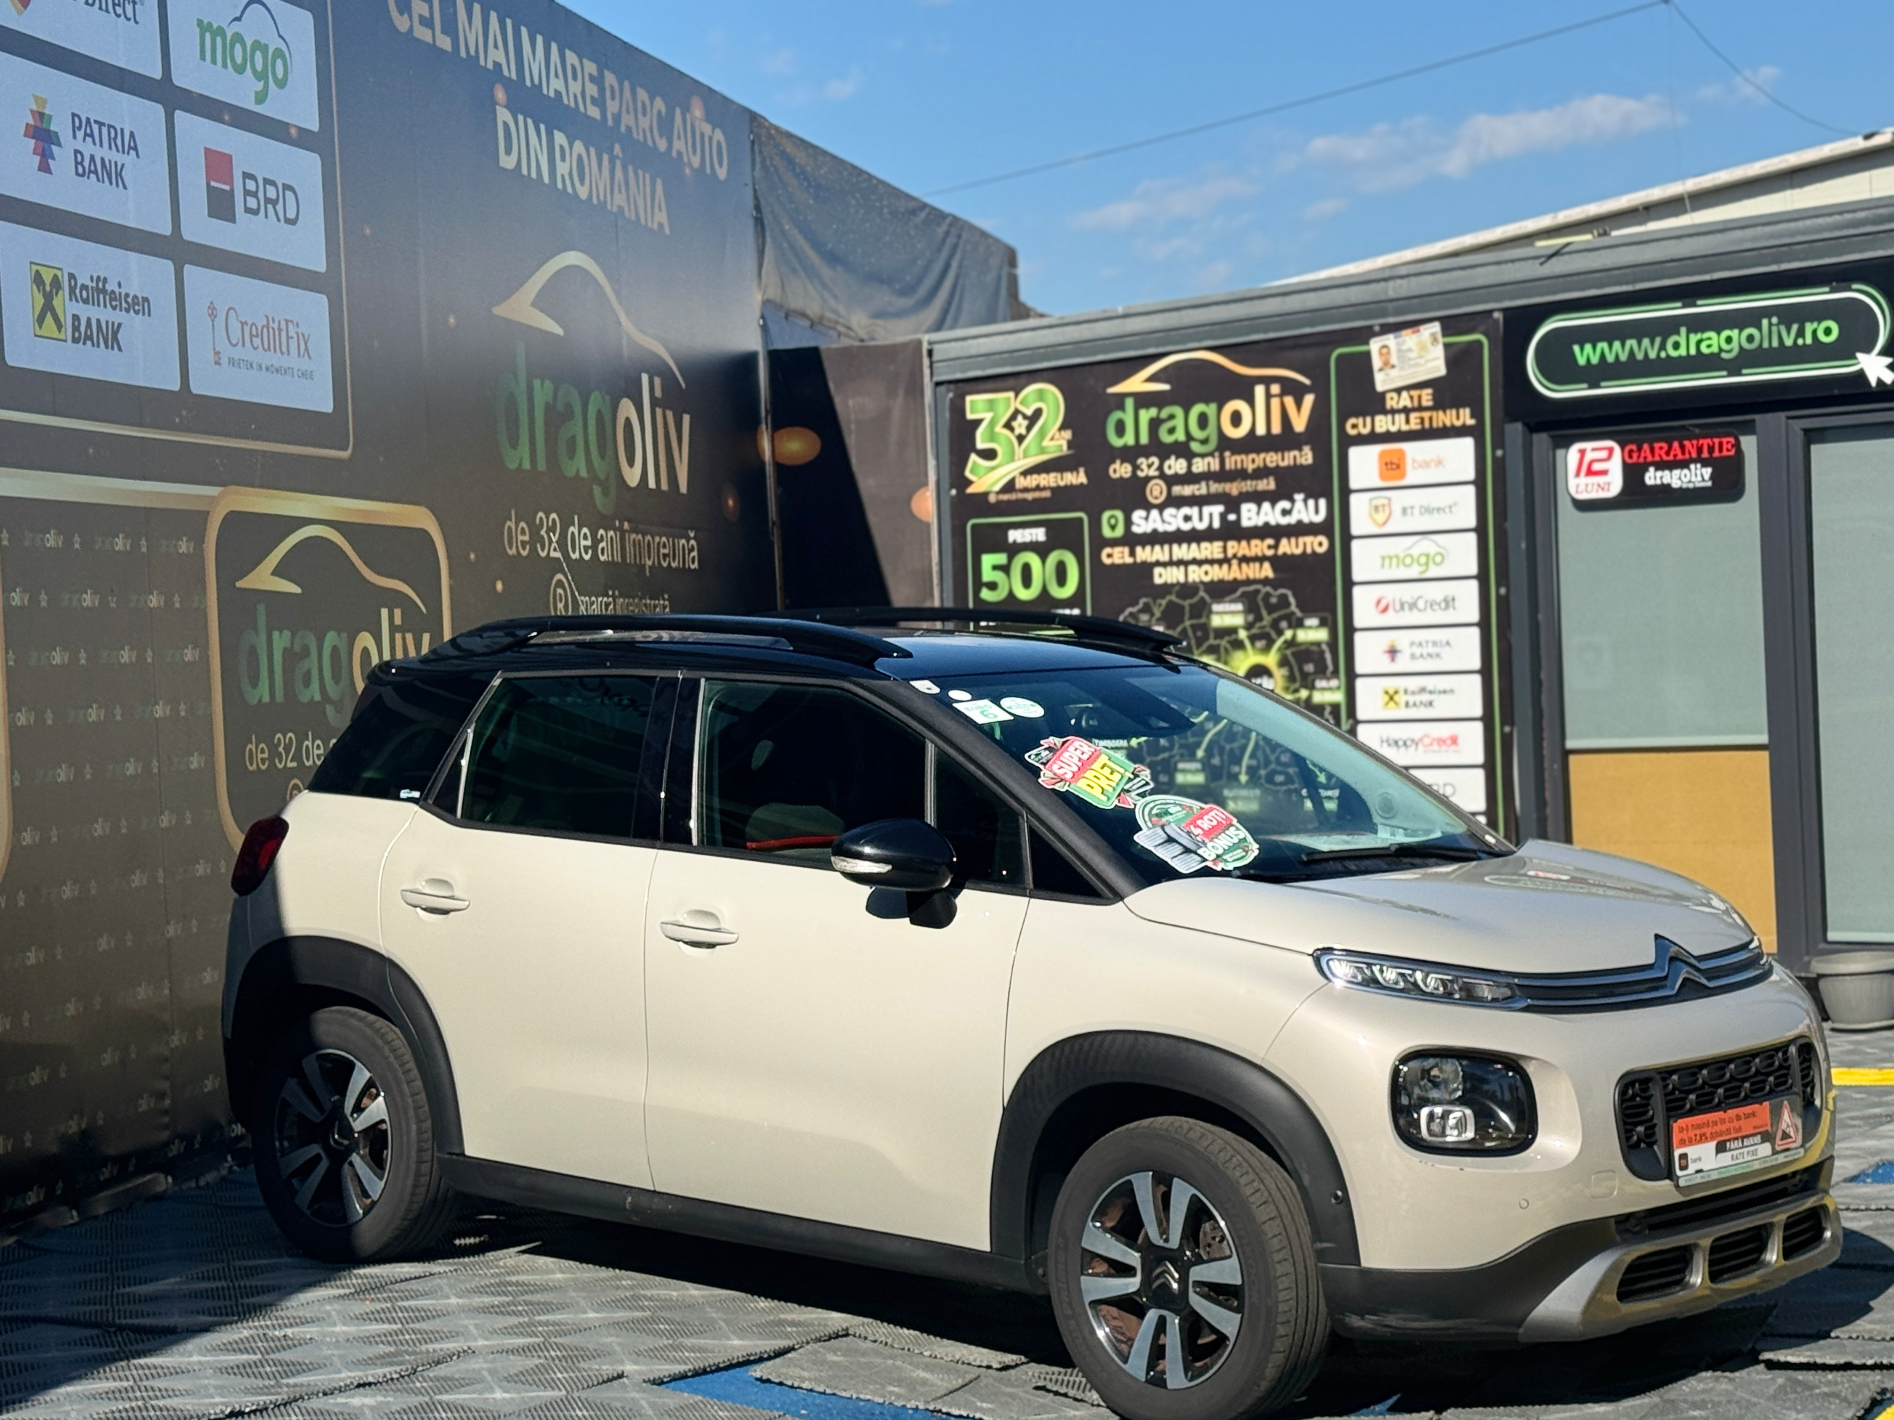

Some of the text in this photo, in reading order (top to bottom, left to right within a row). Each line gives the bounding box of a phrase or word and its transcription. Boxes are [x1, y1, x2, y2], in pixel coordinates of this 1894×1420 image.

[196, 17, 290, 105] mogo
[456, 0, 517, 81] MAI
[520, 25, 601, 122] MARE
[603, 68, 668, 152] PARC
[671, 105, 728, 182] AUTO
[70, 110, 141, 160] PATRIA
[72, 148, 129, 191] BANK
[495, 104, 671, 236] DIN ROMÂNIA
[241, 169, 301, 227] BRD
[66, 271, 152, 318] Raiffeisen
[70, 313, 124, 353] BANK
[223, 305, 313, 361] CreditFix
[1572, 315, 1841, 367] www.dragoliv.ro
[1104, 382, 1316, 455] dragoliv
[1384, 388, 1435, 411] RATE
[496, 341, 691, 516] dragoliv
[1344, 406, 1477, 436] CU BULETINUL
[1107, 445, 1314, 480] de 32 de ani împreună
[1410, 455, 1447, 470] bank
[1574, 445, 1615, 478] 12
[1623, 436, 1736, 464] GARANTIE
[1574, 481, 1612, 495] LUNI
[1644, 462, 1713, 489] dragoliv
[1130, 503, 1225, 535] SASCUT
[1239, 493, 1328, 529] BACĂU
[503, 509, 700, 577] de 32 de ani împreună
[1007, 527, 1047, 545] PESTE
[1100, 533, 1330, 566] CEL MAI MARE PARC AUTO
[978, 548, 1080, 603] 500
[1152, 558, 1276, 586] DIN ROMÂNIA
[1379, 550, 1446, 576] mogo
[1391, 594, 1458, 615] UniCredit
[244, 734, 270, 771] de
[274, 732, 298, 769] 32
[1051, 739, 1097, 780] SUPER
[1379, 732, 1460, 752] HappyCredit
[1196, 825, 1246, 862] BONUS
